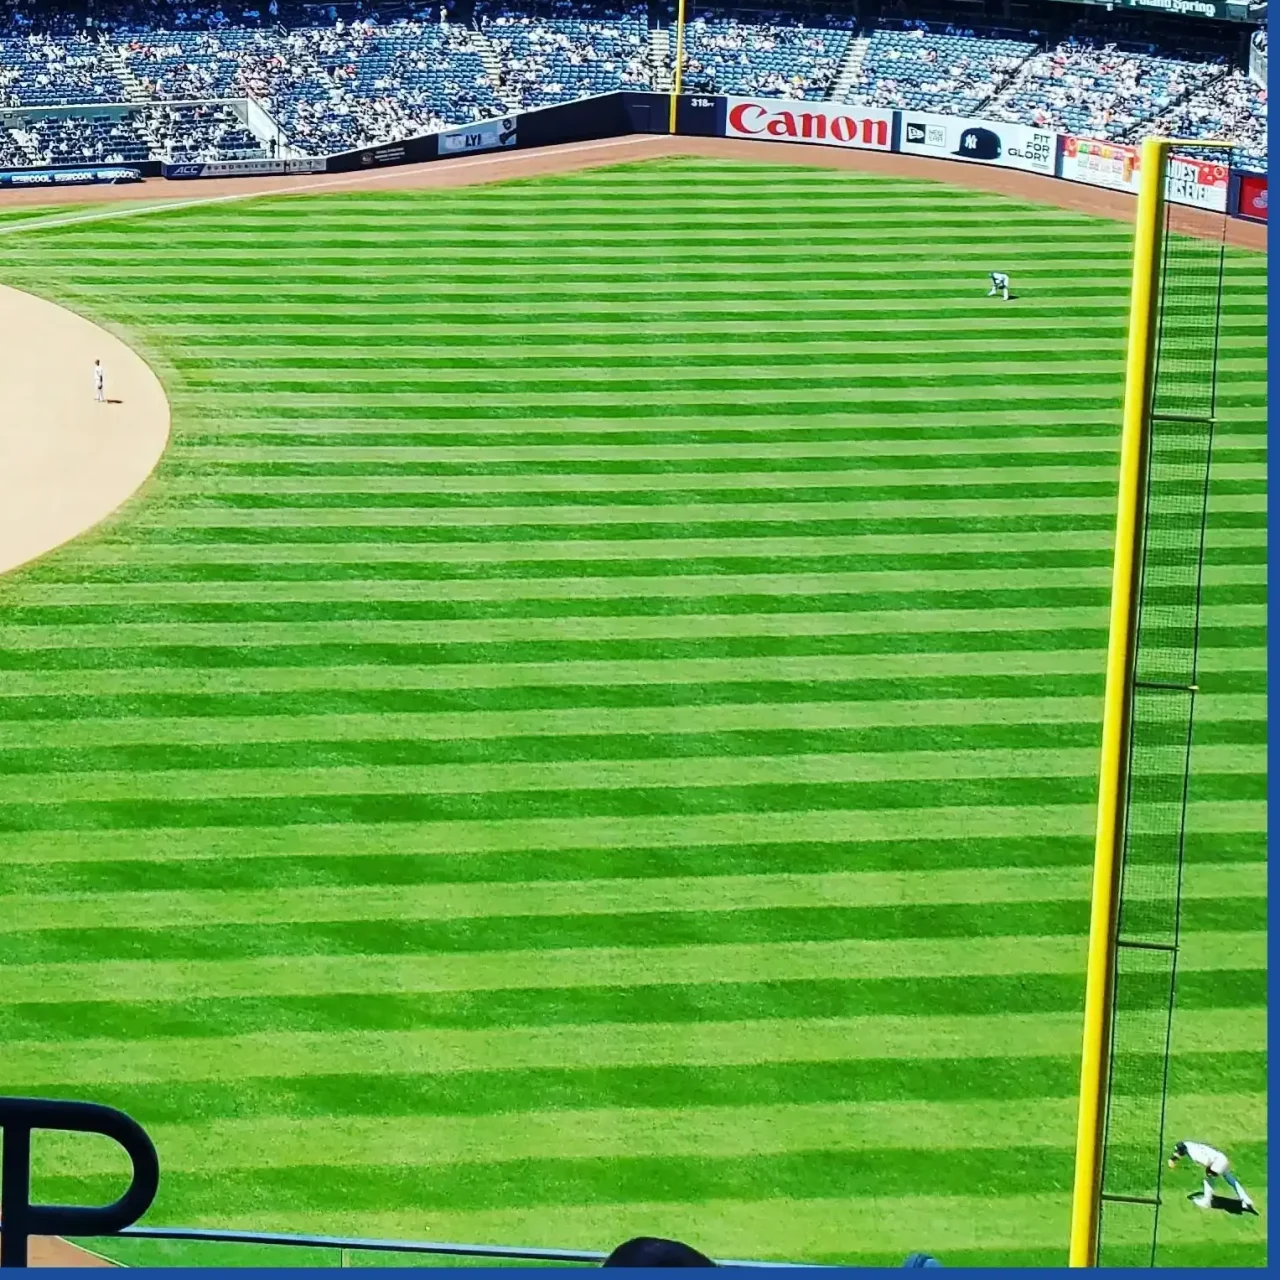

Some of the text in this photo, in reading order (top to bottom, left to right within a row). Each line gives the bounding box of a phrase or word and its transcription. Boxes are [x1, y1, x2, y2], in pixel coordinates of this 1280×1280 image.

[729, 103, 887, 145] Canon
[1033, 133, 1050, 143] FIT
[1026, 142, 1050, 154] FOR
[1008, 148, 1049, 163] GLORY
[174, 165, 199, 174] ACC
